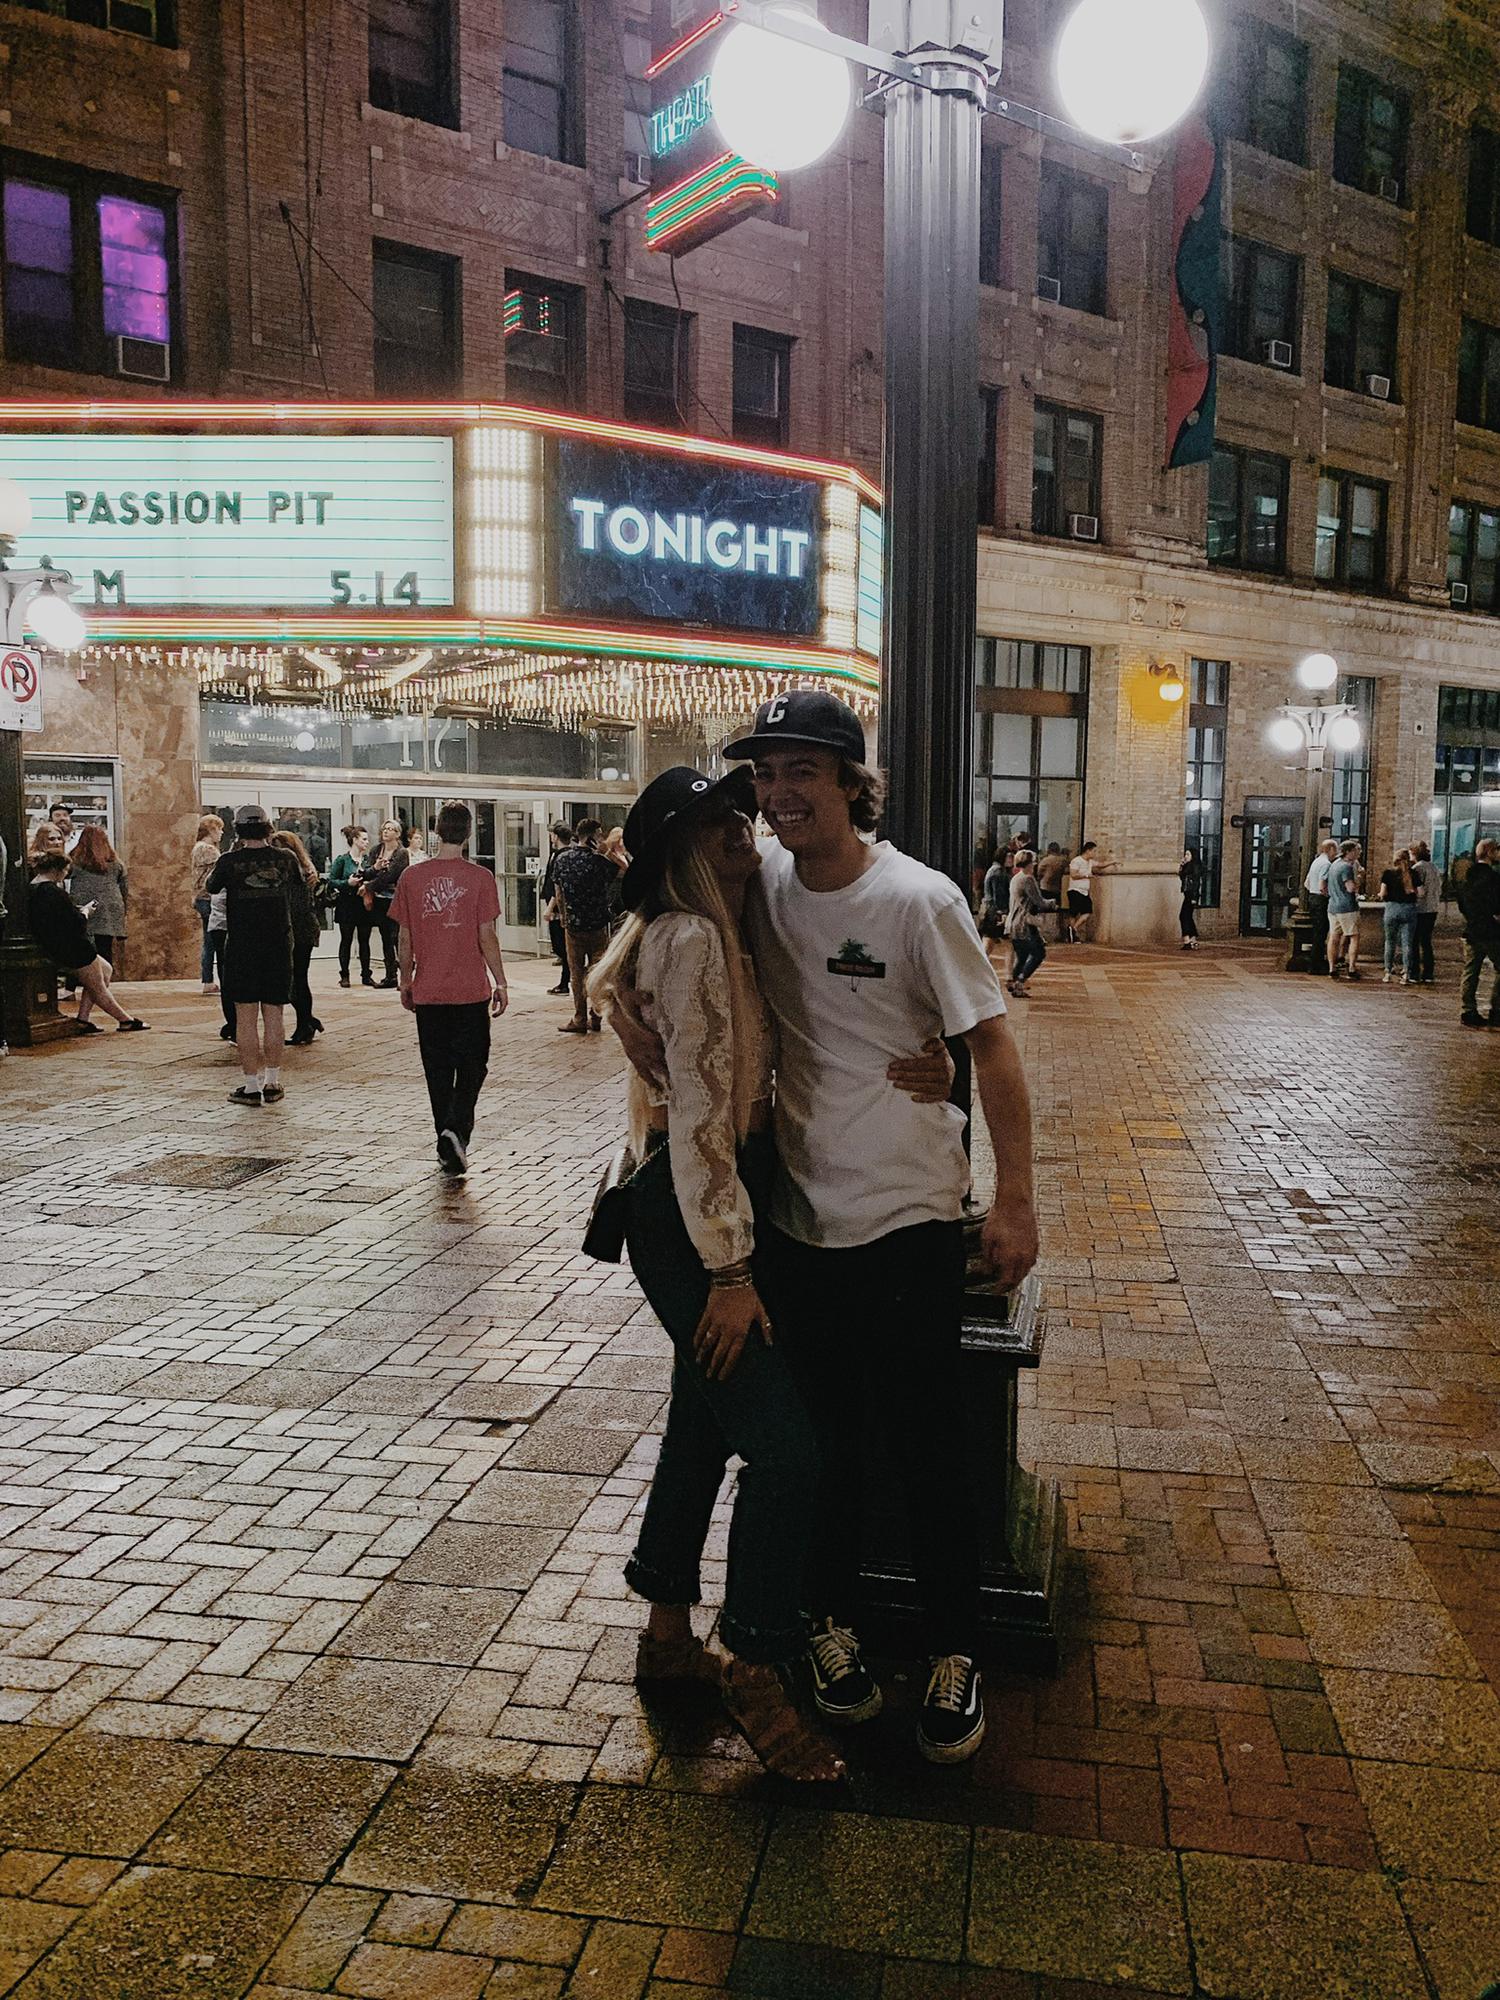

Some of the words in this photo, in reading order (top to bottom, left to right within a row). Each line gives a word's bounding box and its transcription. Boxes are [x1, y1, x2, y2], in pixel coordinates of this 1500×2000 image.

[65, 490, 241, 525] PASSION
[268, 491, 333, 526] PIT
[572, 497, 809, 578] TONIGHT
[93, 568, 125, 605] M
[331, 570, 421, 606] 5.14
[766, 697, 789, 724] G
[49, 773, 95, 782] THEATRE
